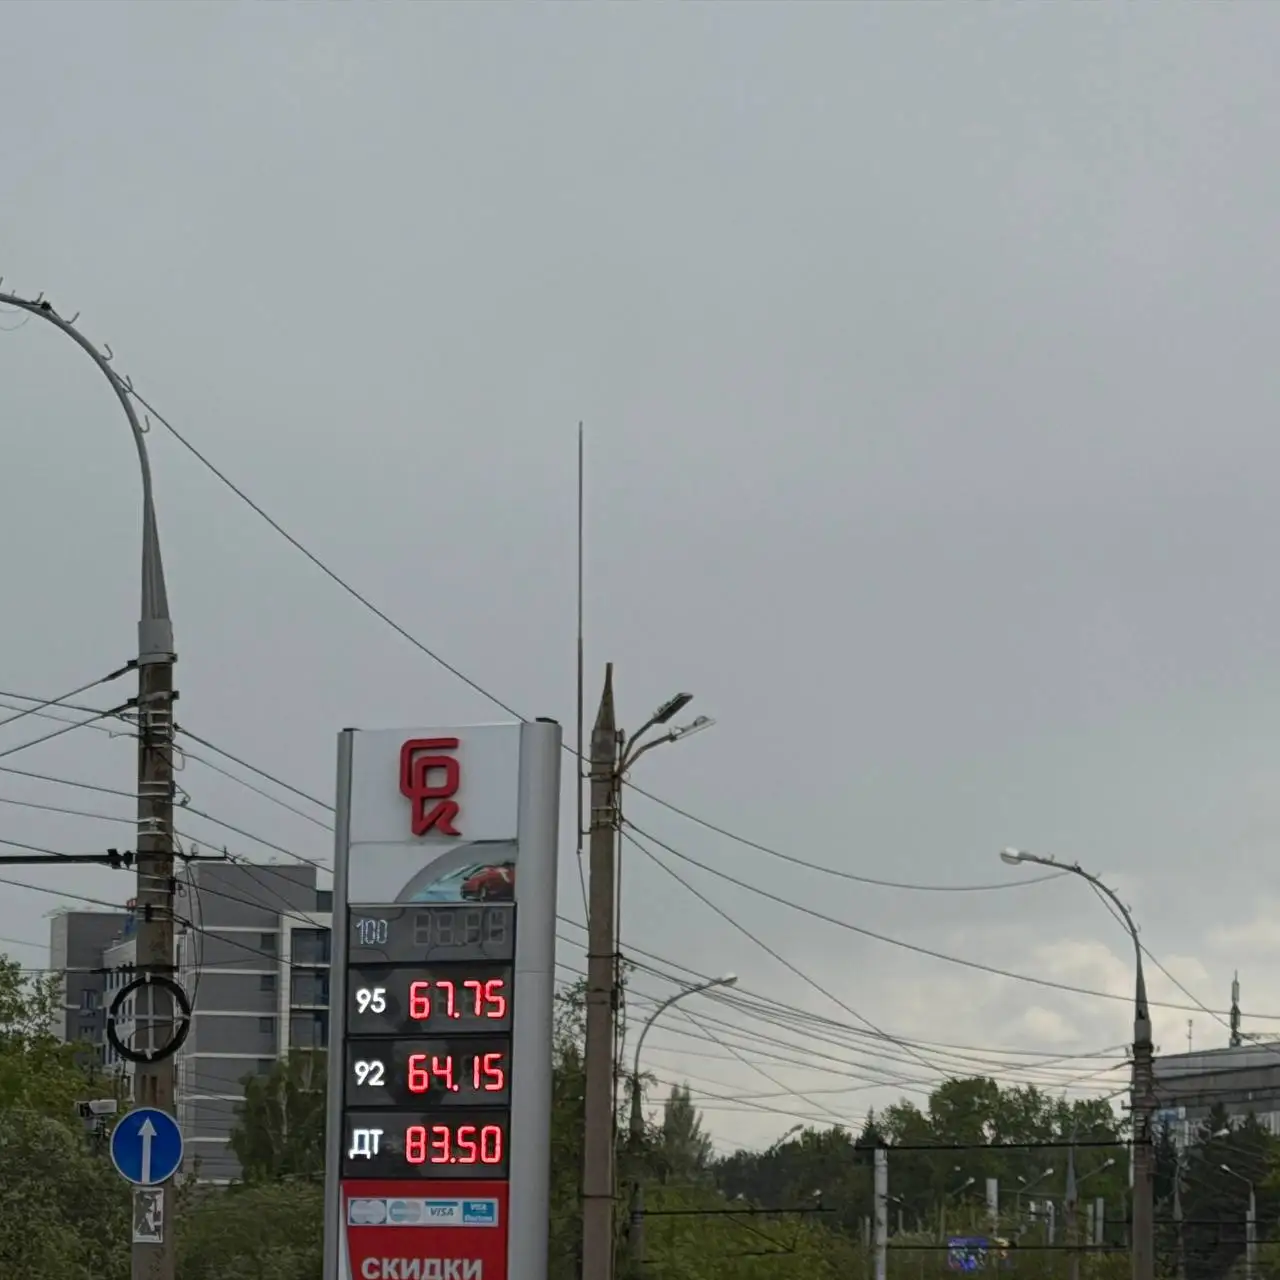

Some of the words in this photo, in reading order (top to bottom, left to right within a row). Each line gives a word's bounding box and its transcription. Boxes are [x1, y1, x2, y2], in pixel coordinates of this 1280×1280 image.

[356, 919, 388, 945] 100
[356, 988, 386, 1014] 95
[409, 979, 506, 1019] 67.75
[354, 1060, 385, 1087] 92
[407, 1053, 504, 1092] 64.15
[348, 1129, 384, 1160] ДТ
[405, 1125, 502, 1164] 83.50
[430, 1207, 454, 1217] VISA
